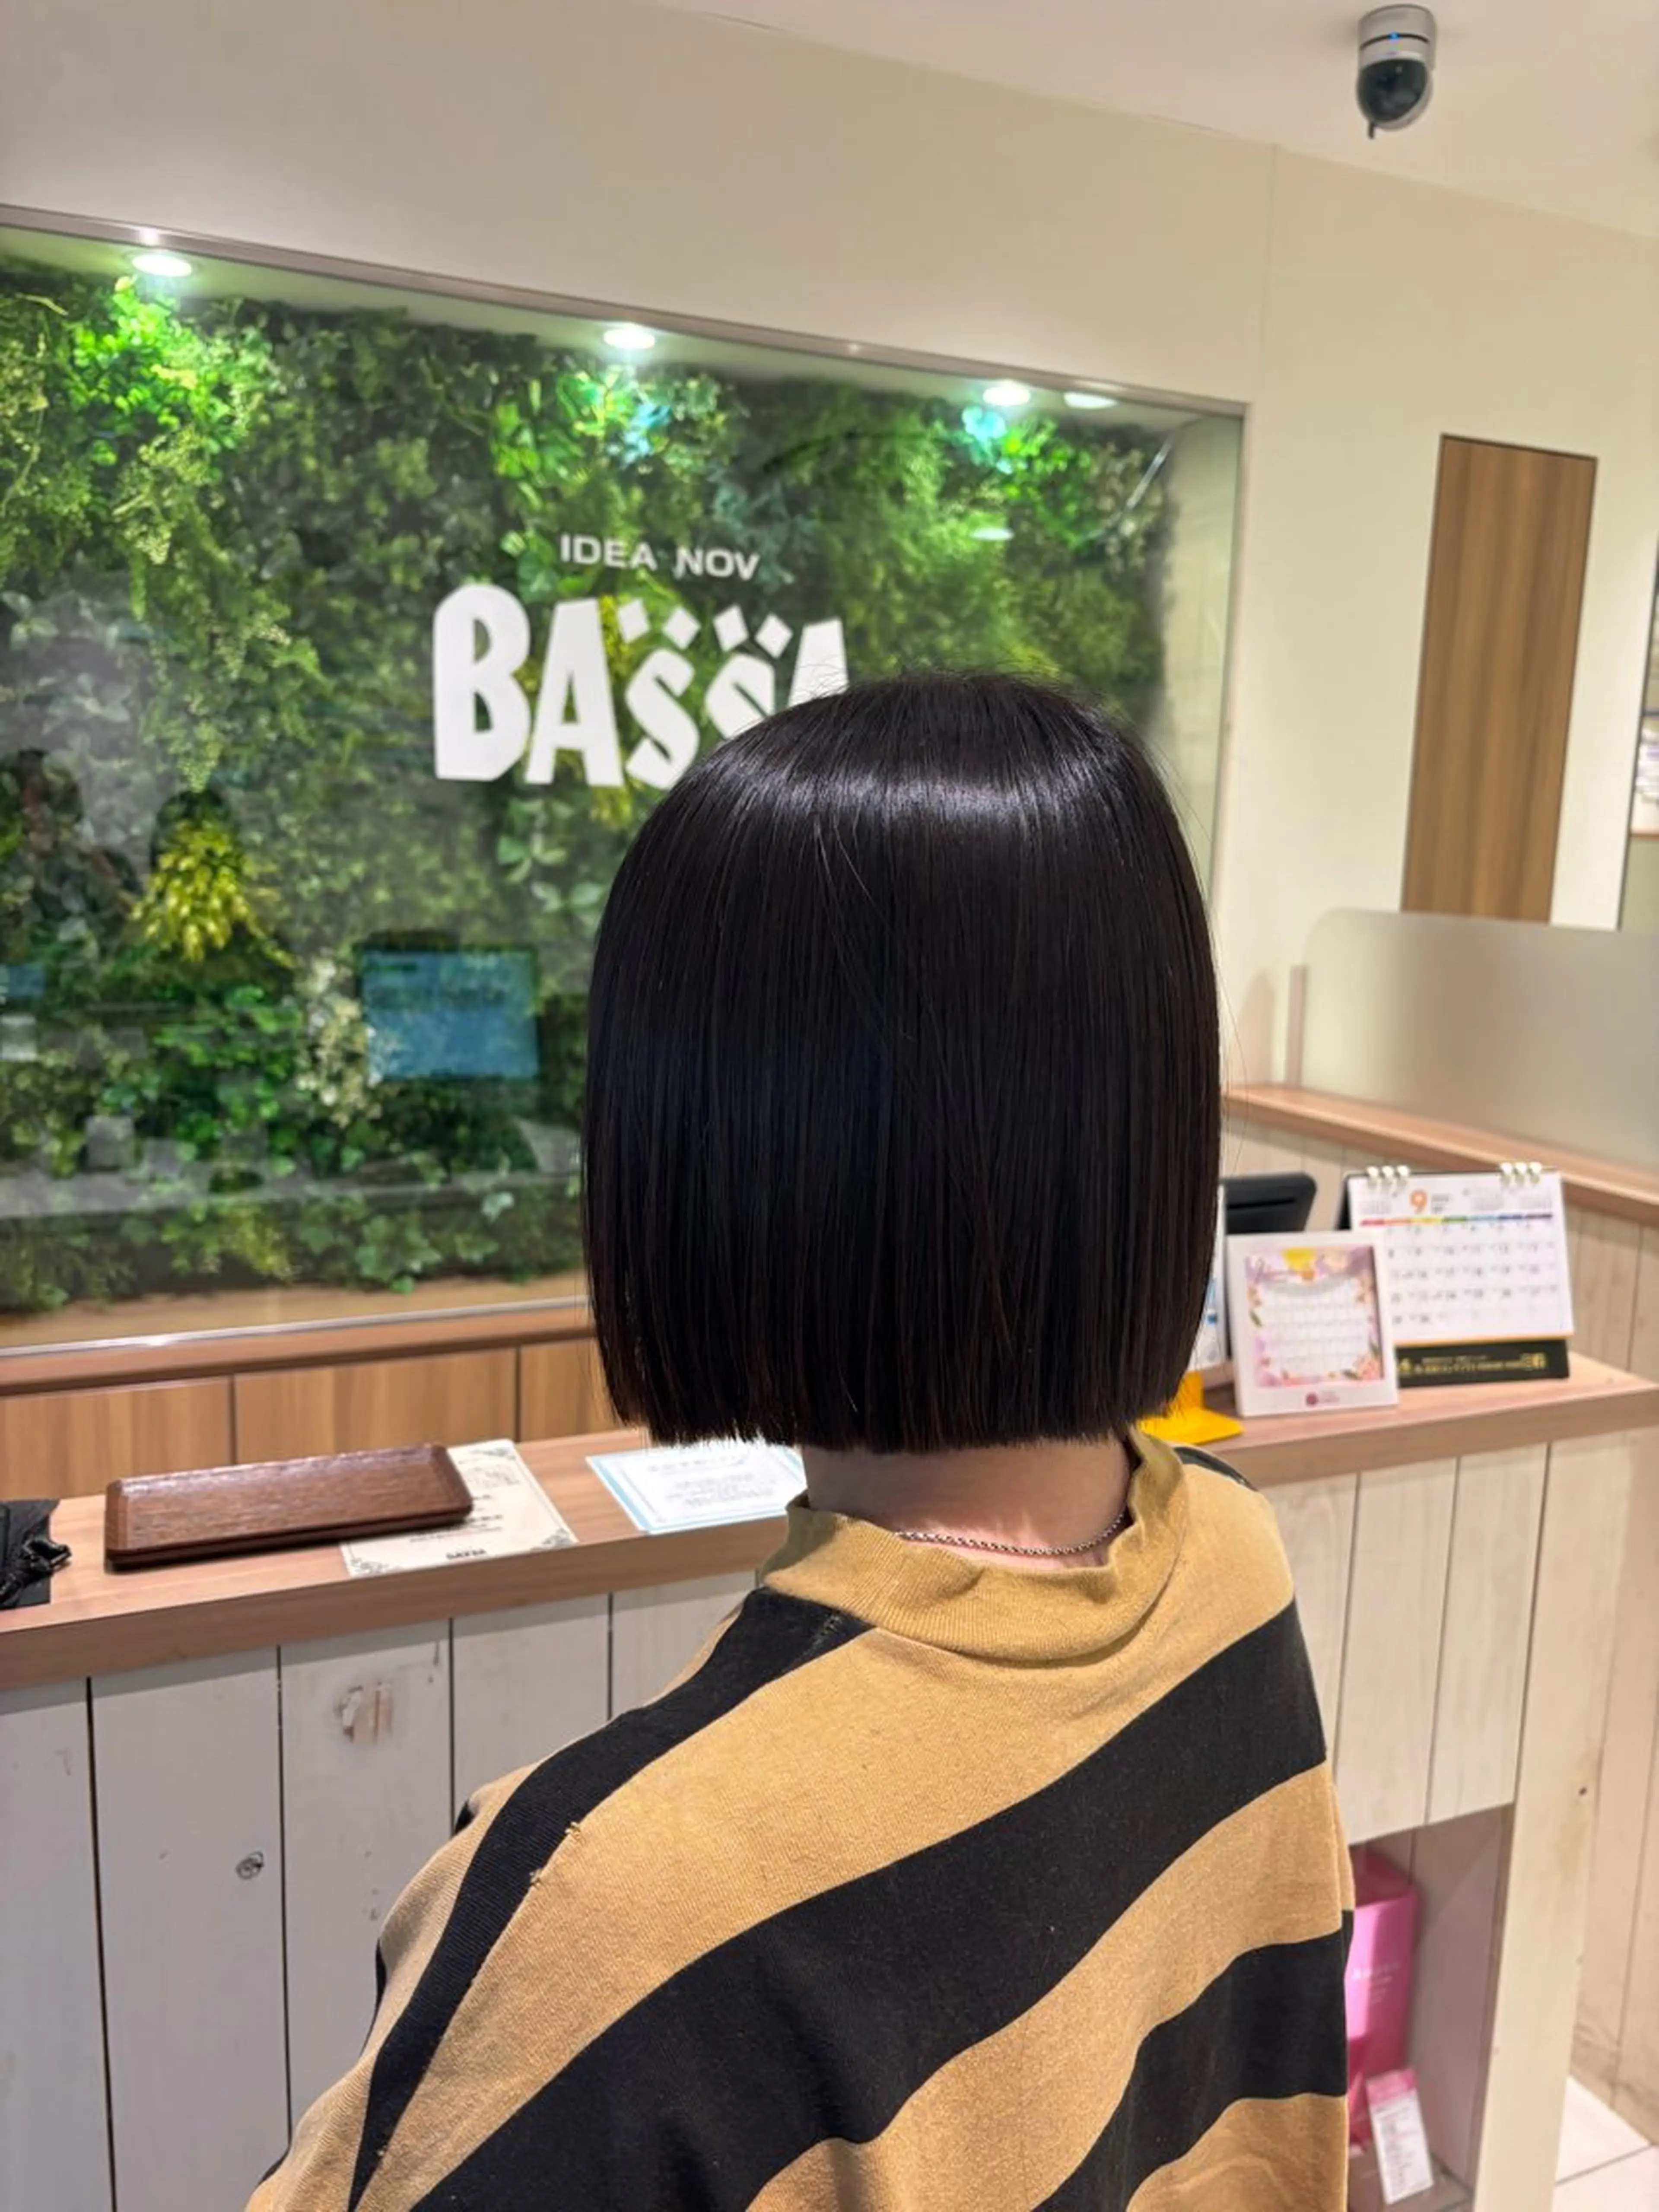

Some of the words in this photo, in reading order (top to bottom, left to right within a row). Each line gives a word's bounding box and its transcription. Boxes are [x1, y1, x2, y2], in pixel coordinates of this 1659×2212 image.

[561, 534, 657, 570] IDEA
[675, 547, 760, 581] NOV
[1410, 1189, 1427, 1215] 9
